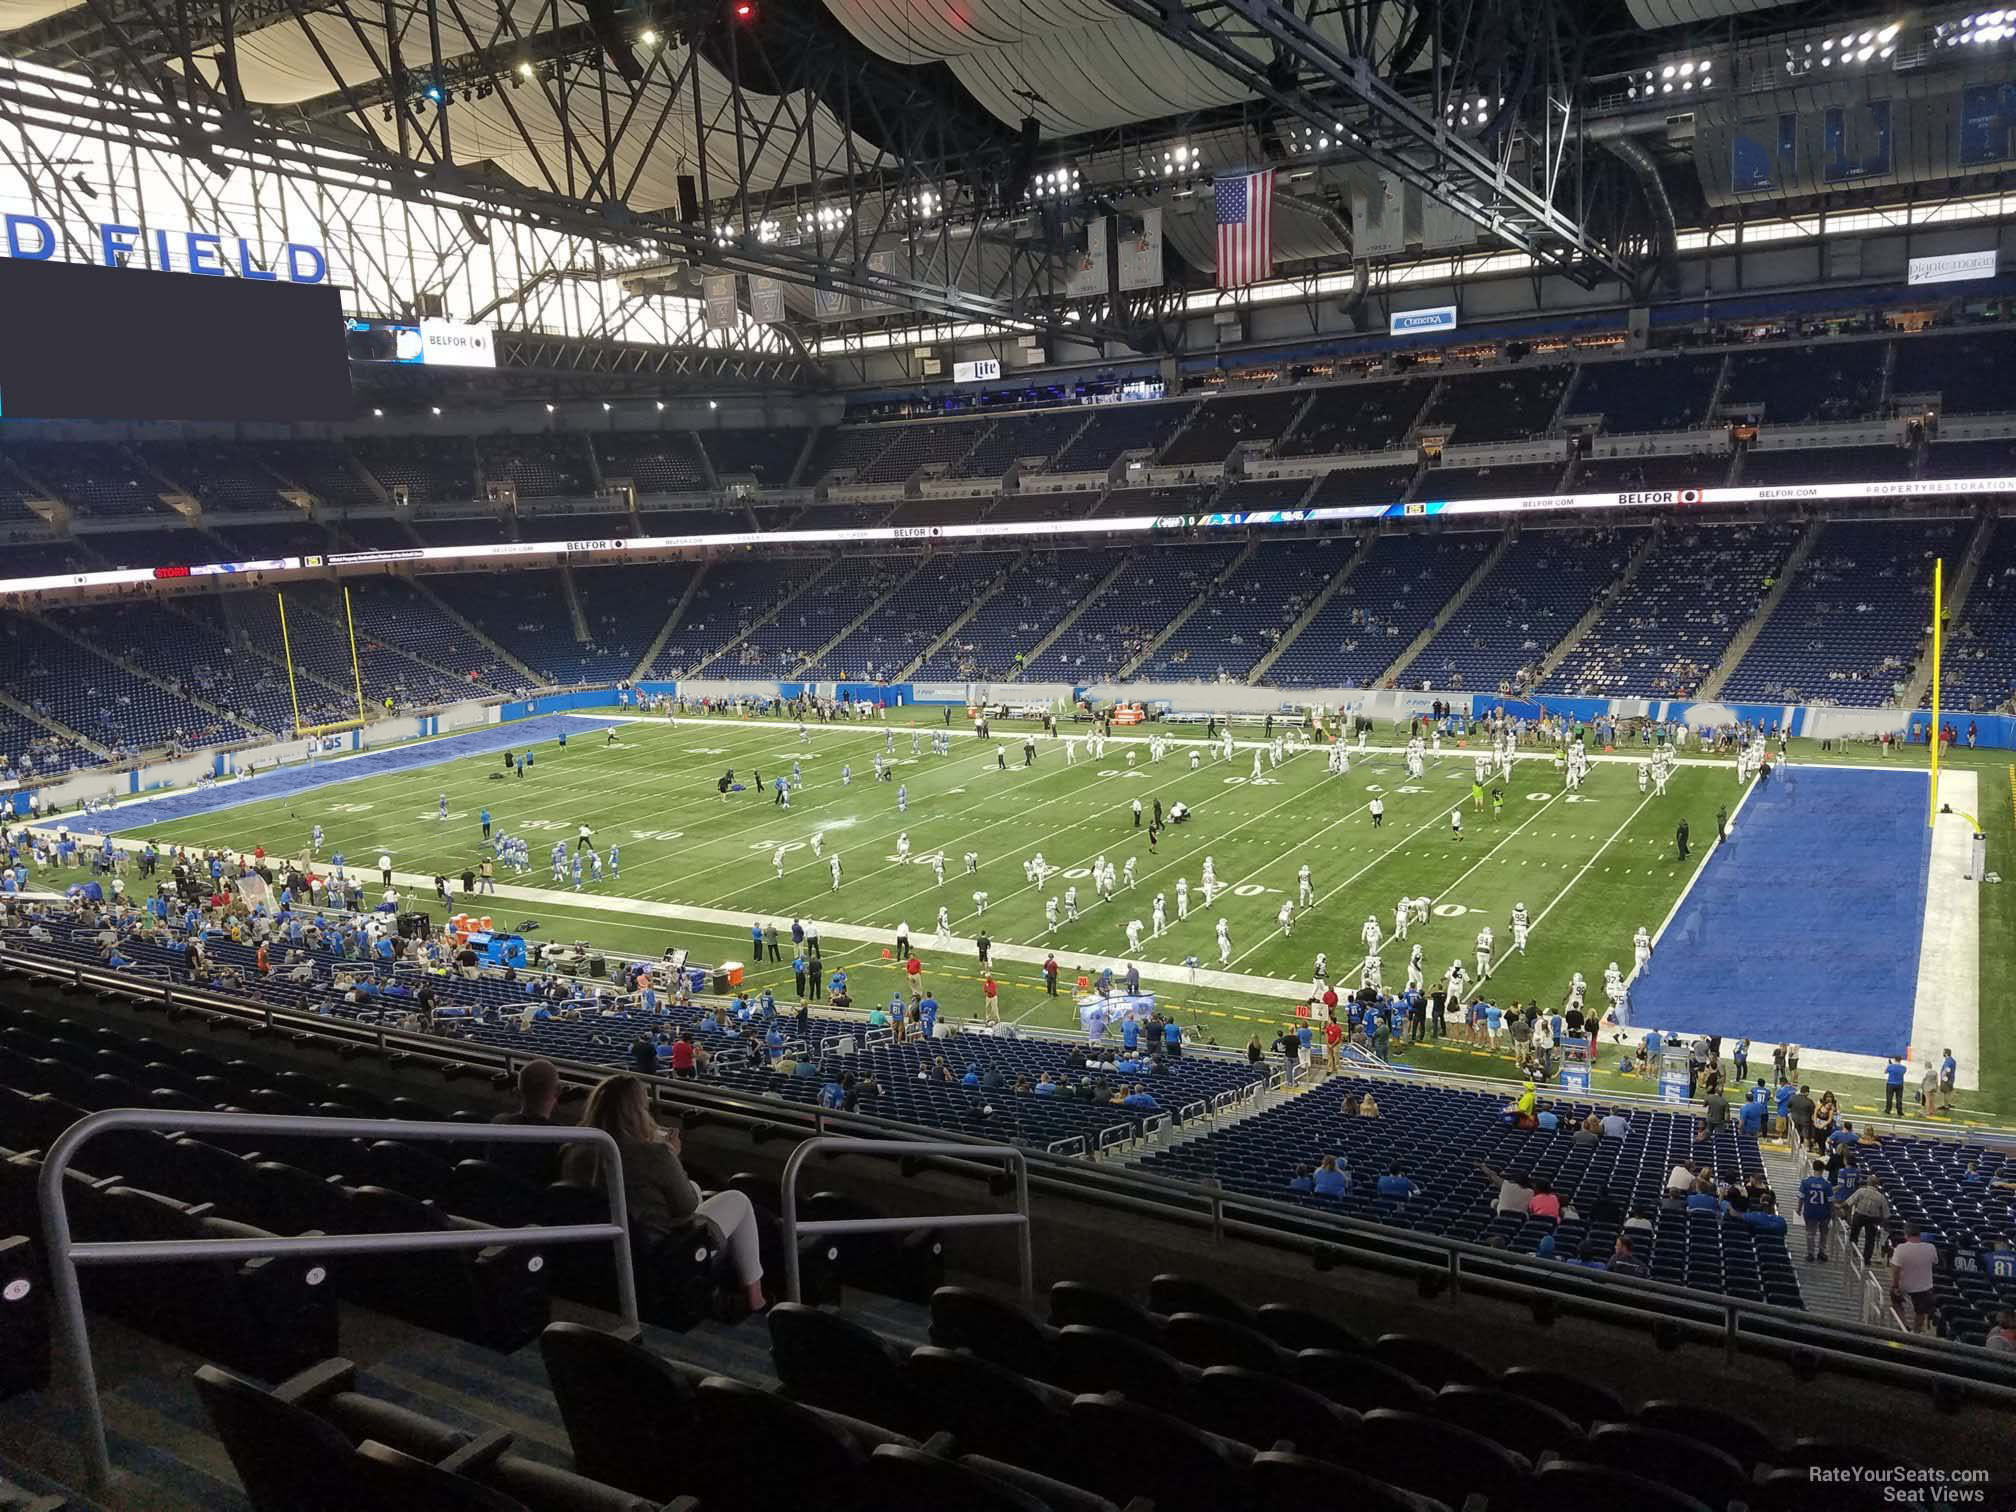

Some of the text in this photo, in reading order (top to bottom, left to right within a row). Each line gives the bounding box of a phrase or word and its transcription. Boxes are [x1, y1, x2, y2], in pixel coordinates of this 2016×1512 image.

[99, 223, 327, 285] FIELD
[429, 335, 467, 346] BELFOR
[1618, 492, 1673, 504] BELFOR
[1759, 488, 1818, 498] BELFOR.COM
[893, 528, 926, 538] BELFOR
[566, 541, 607, 551] BELFOR
[157, 567, 190, 578] STORM
[1514, 913, 1525, 922] 92
[1809, 1190, 1824, 1205] 21
